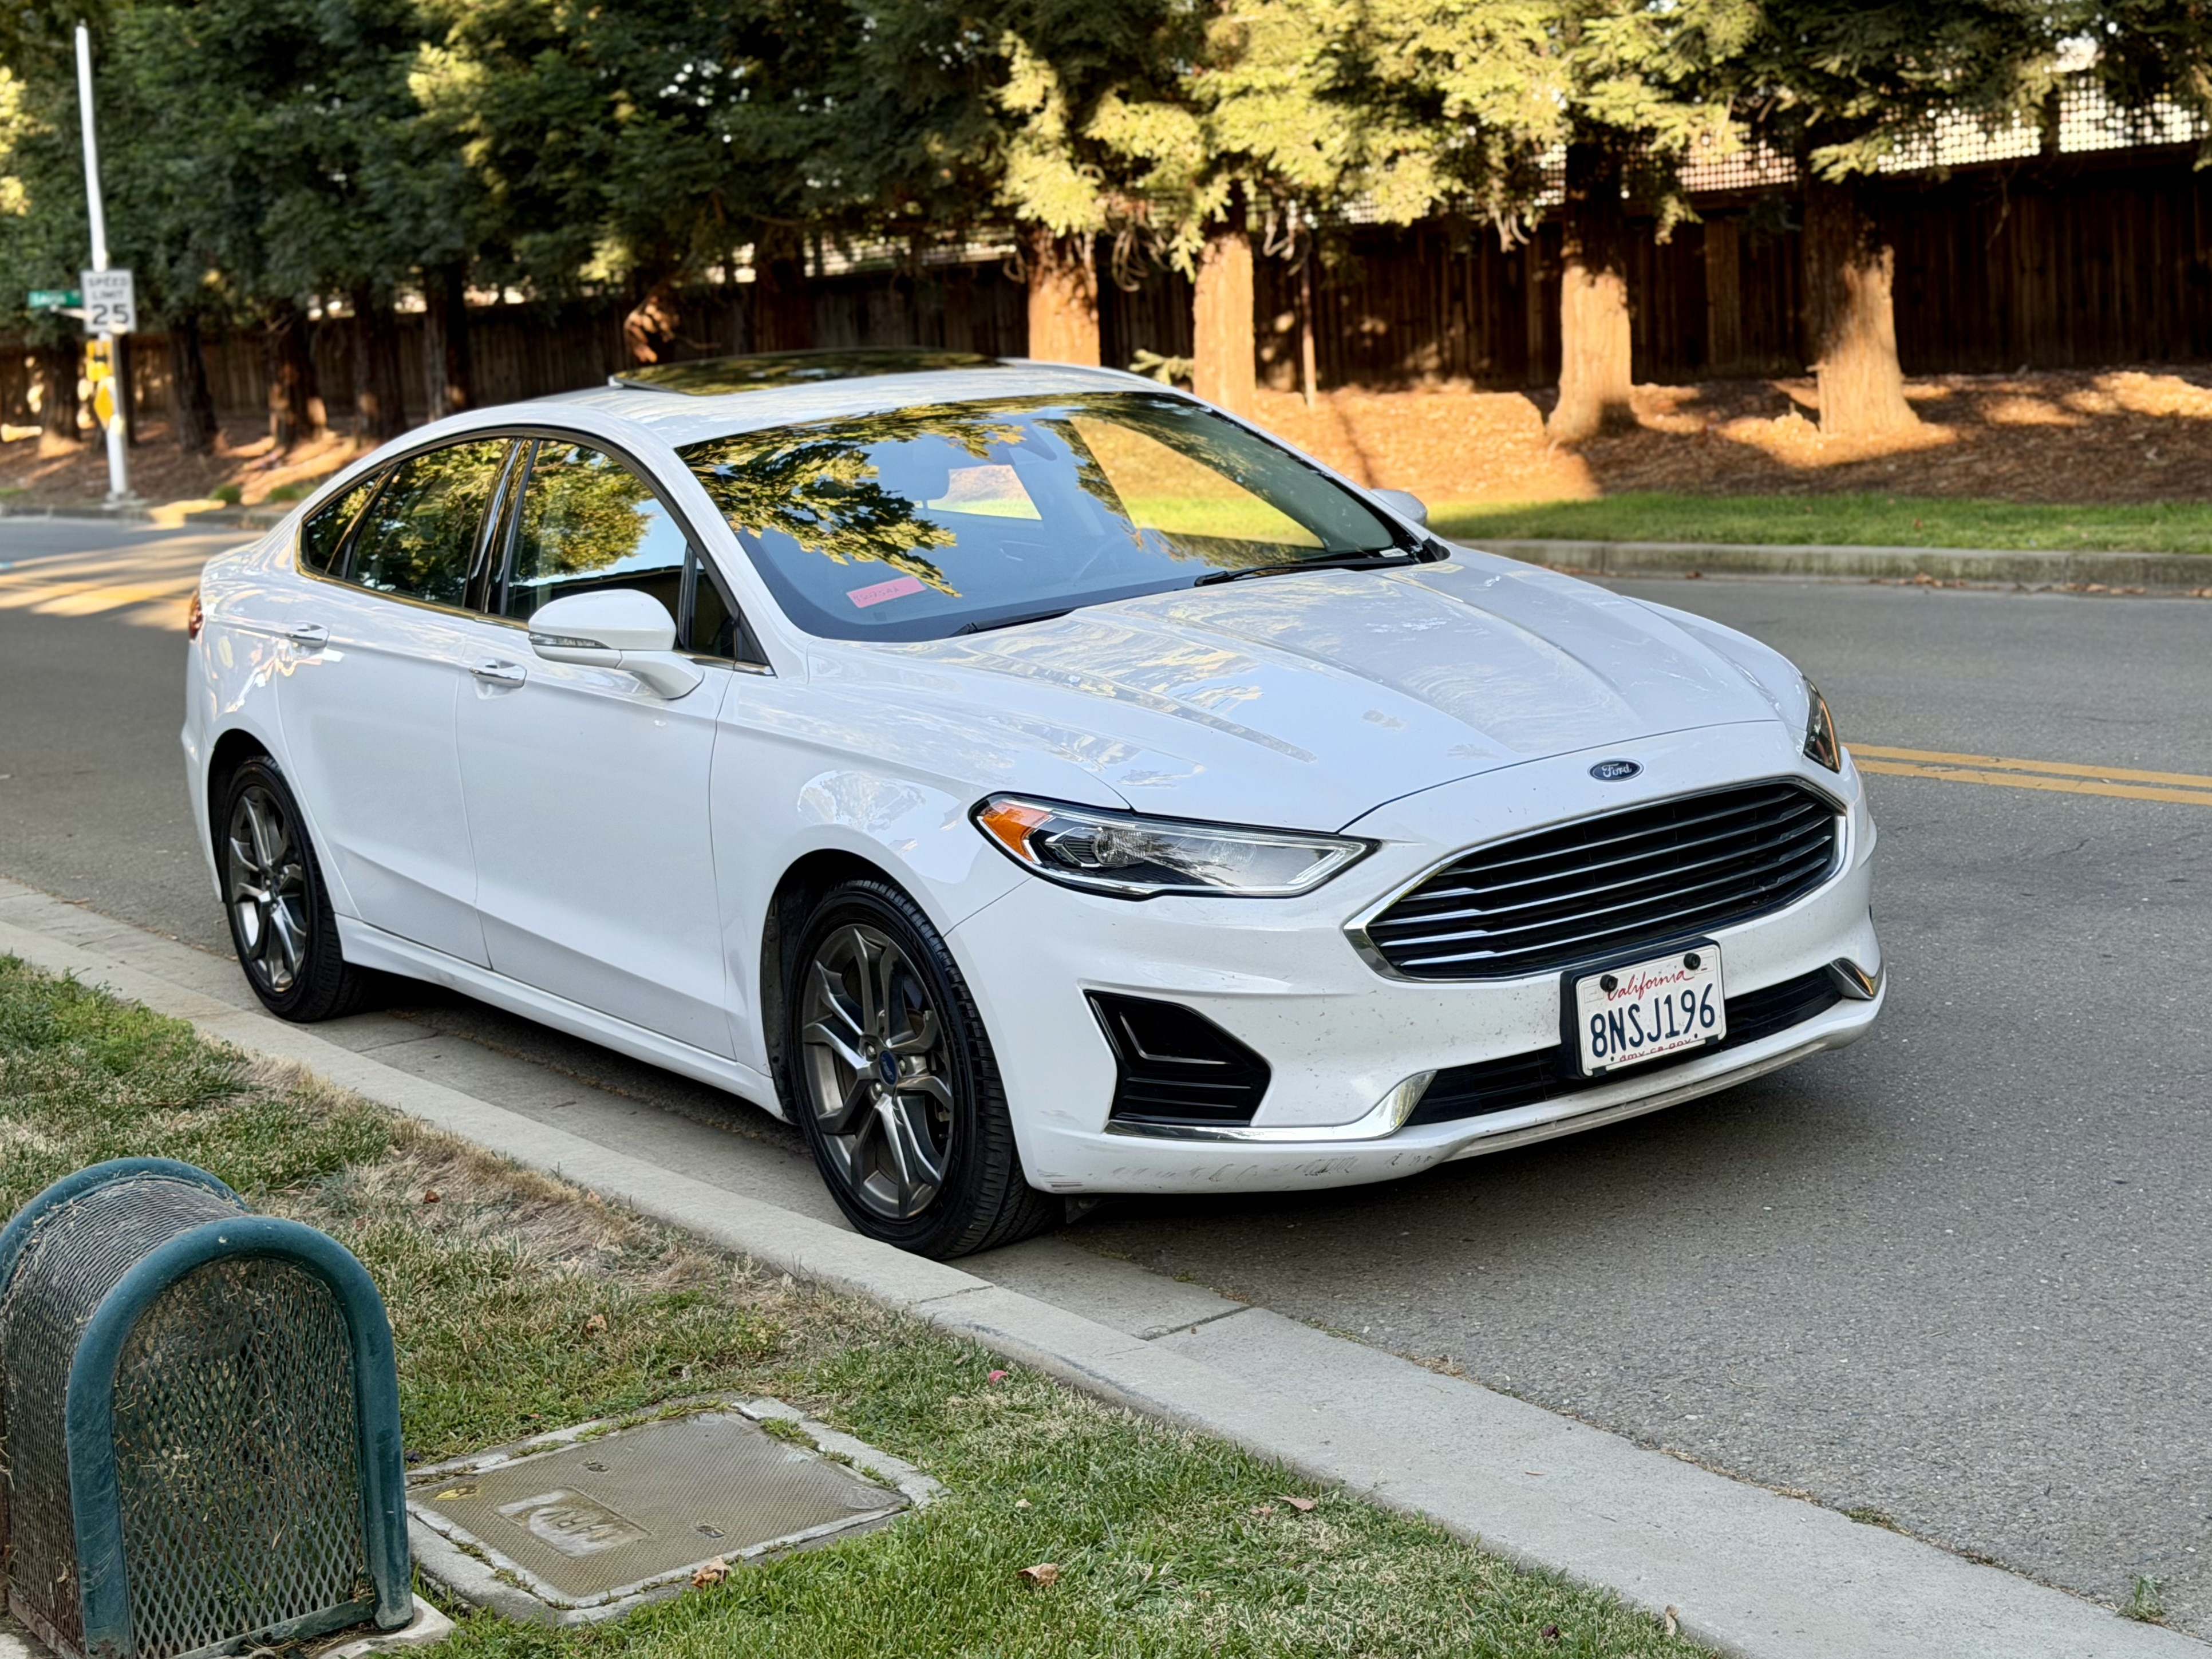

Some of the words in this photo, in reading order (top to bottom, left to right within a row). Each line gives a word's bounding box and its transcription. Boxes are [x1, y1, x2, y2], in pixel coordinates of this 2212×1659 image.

[88, 276, 128, 287] SPEED
[92, 290, 124, 300] LIMIT
[92, 303, 129, 325] 25
[1601, 763, 1632, 778] Ford
[1590, 983, 1715, 1058] 8NSJ196
